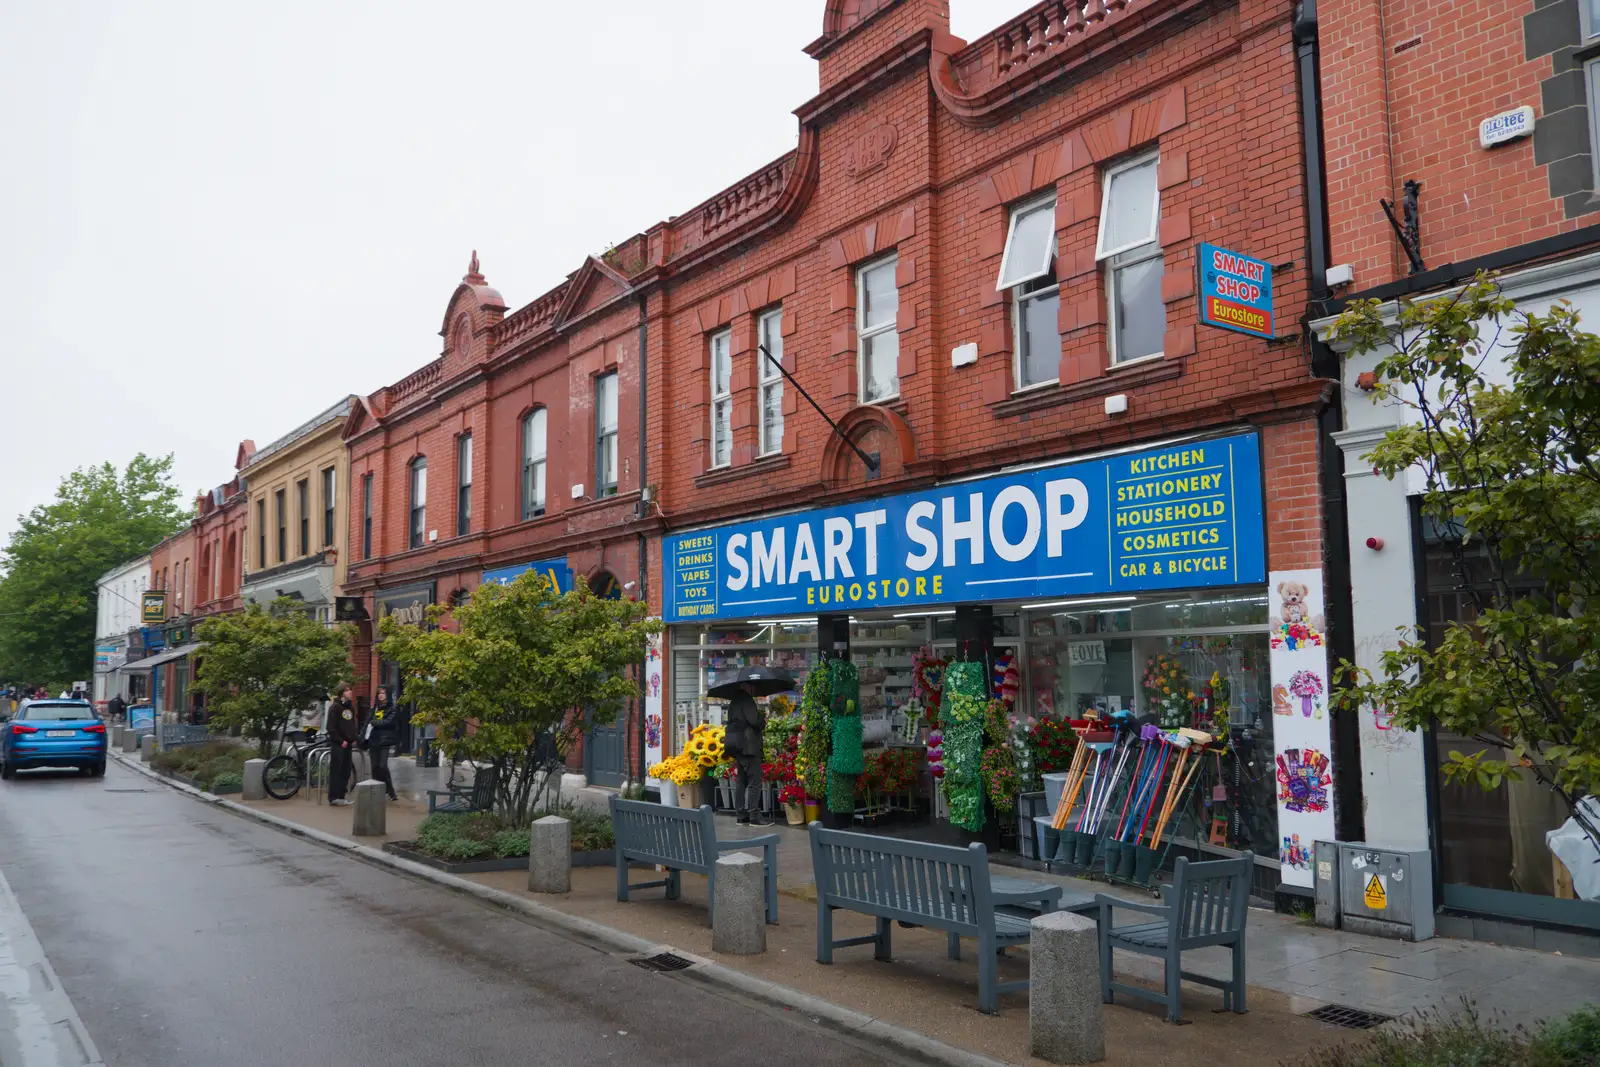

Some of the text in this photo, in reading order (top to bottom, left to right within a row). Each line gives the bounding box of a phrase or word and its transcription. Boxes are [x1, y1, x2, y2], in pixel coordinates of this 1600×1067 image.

[1484, 113, 1524, 134] protec
[1213, 250, 1264, 283] SMART
[1216, 275, 1260, 304] SHOP
[1213, 298, 1264, 327] Eurostore
[1130, 448, 1205, 474] KITCHEN
[1117, 472, 1222, 502] STATIONERY
[1116, 500, 1225, 527] HOUSEHOLD
[678, 535, 713, 551] SWEETS
[726, 477, 1089, 592] SMART SHOP
[1122, 527, 1220, 552] COSMETICS
[678, 552, 713, 567] DRINKS
[1120, 556, 1227, 578] CAR & BICYCLE
[681, 569, 711, 582] VAPES
[684, 586, 708, 598] TOYS
[806, 574, 943, 605] EUROSTORE
[144, 598, 164, 607] King
[678, 603, 715, 617] BIRTHDAY CARDS
[1071, 643, 1103, 661] LOVE
